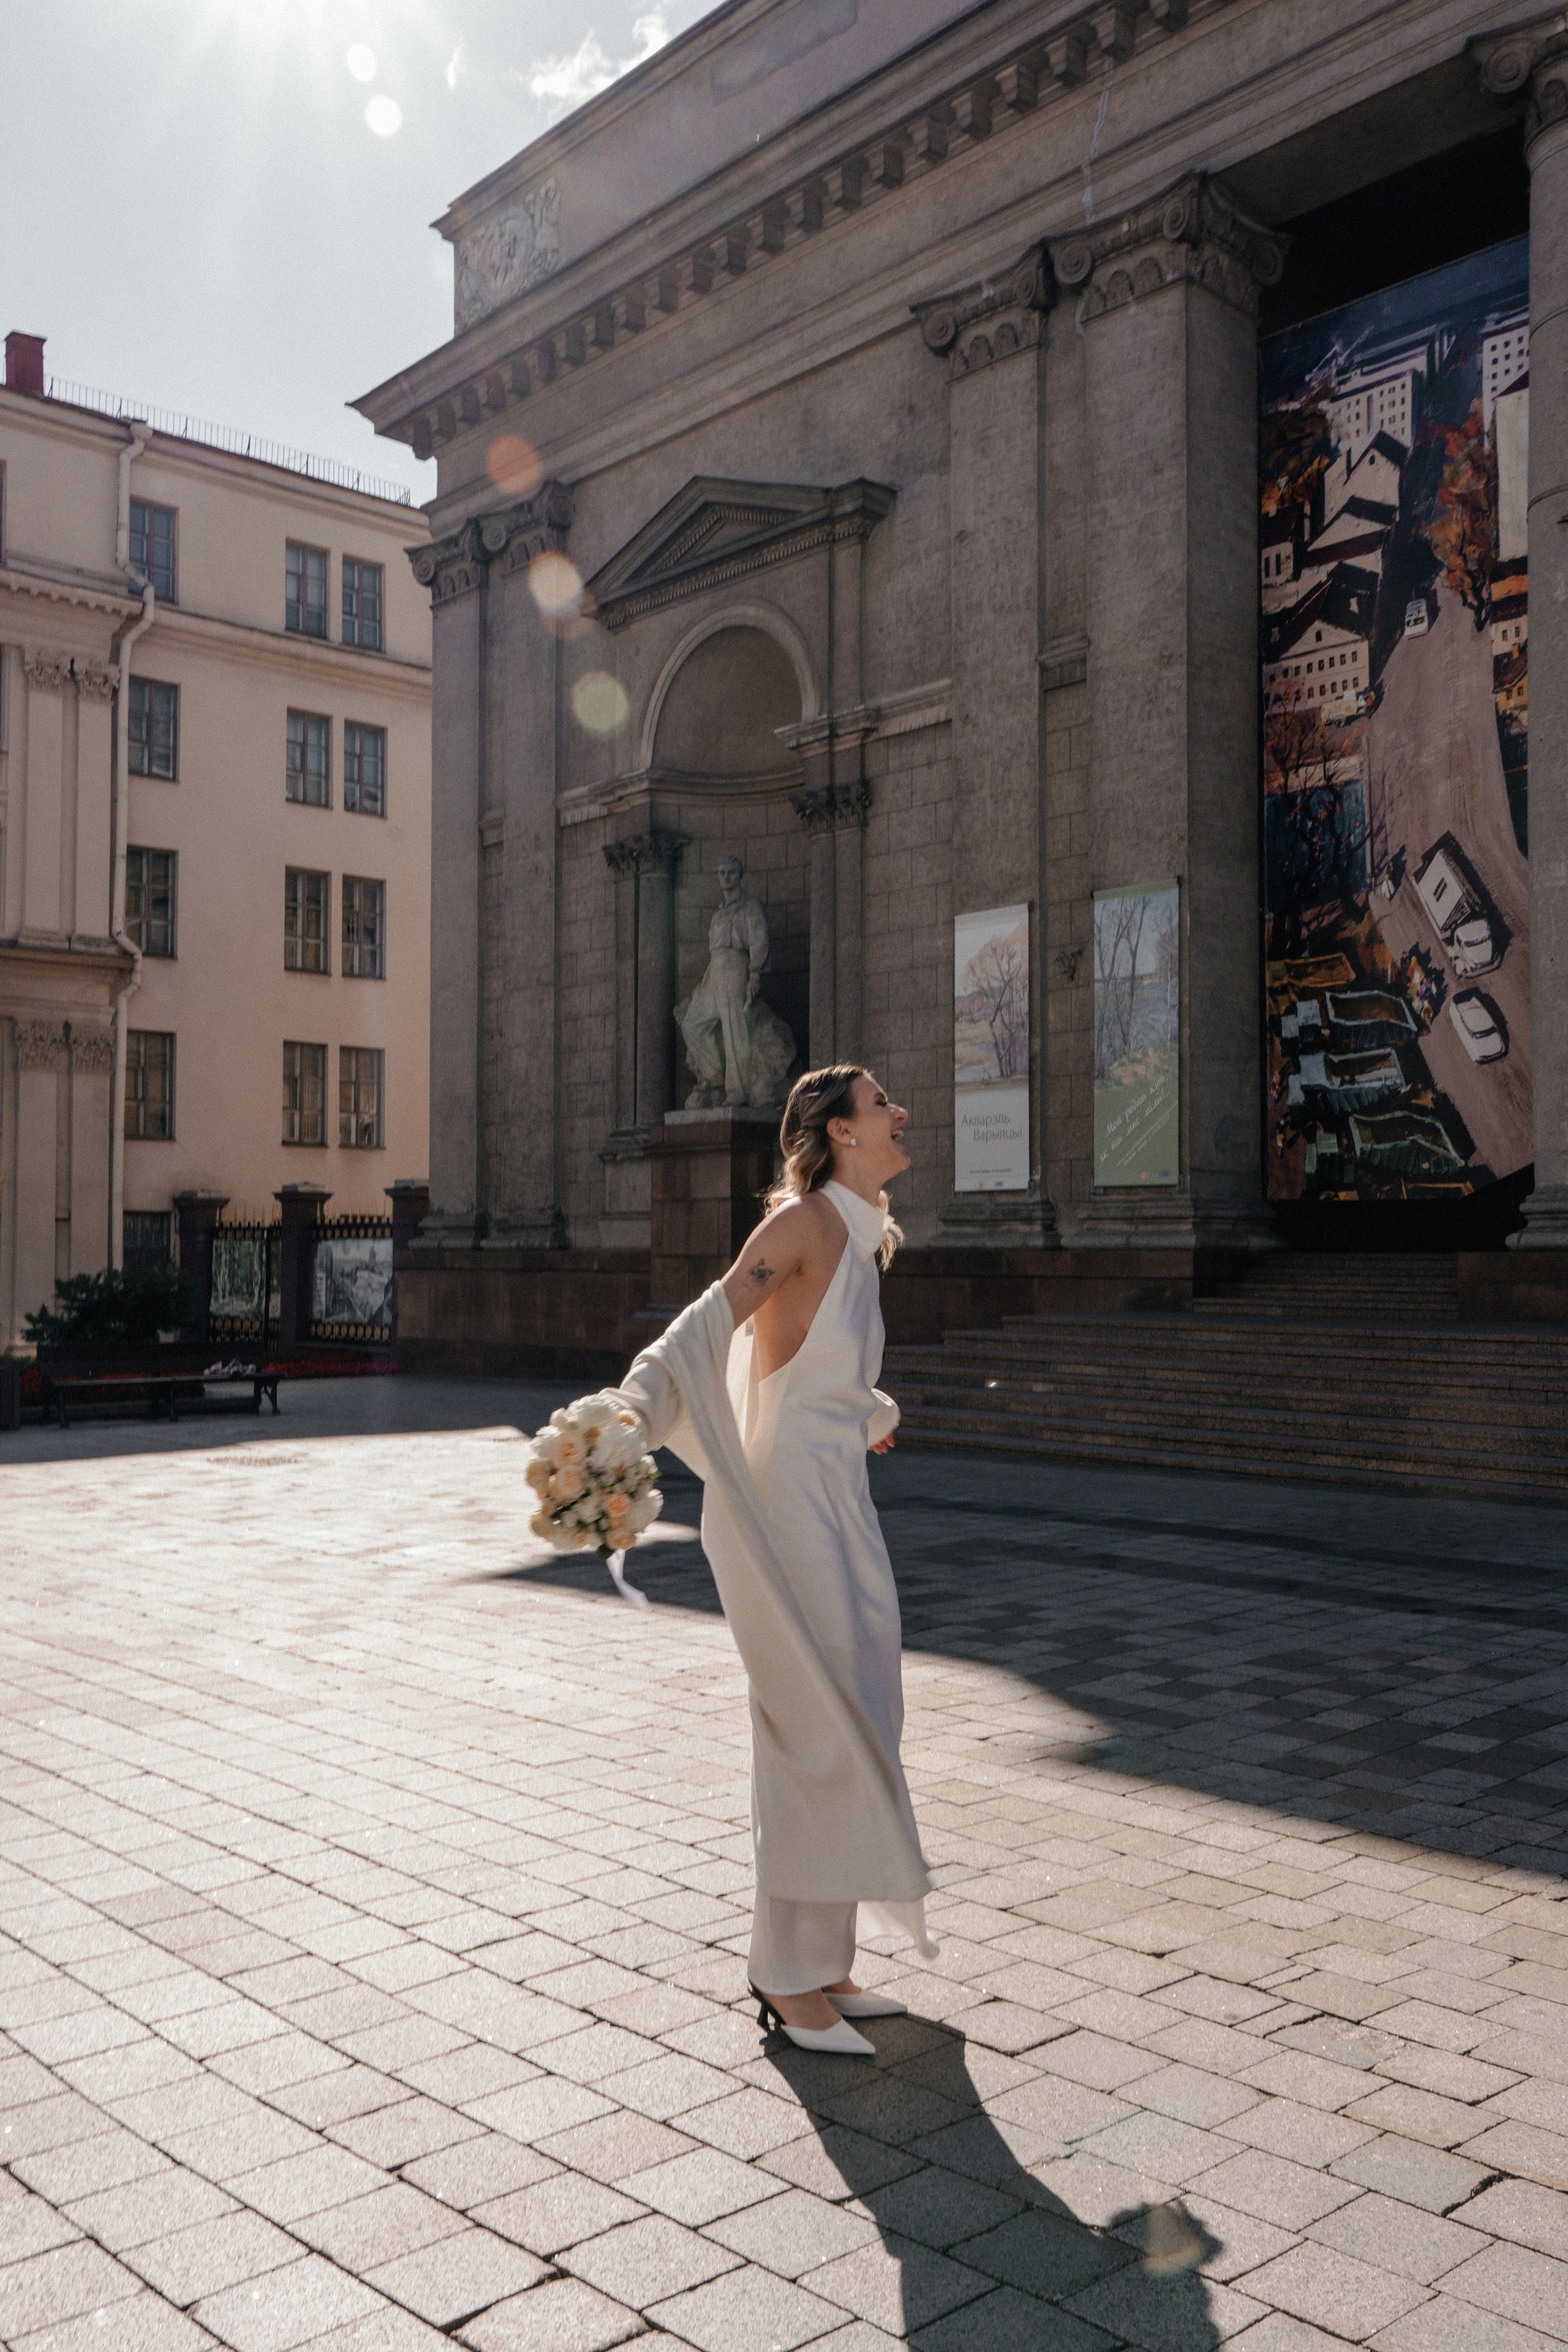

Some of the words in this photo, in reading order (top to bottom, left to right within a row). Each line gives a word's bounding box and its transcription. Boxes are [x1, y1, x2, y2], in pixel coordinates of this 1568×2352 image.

[973, 1126, 1022, 1144] Варыяцыі
[1106, 1115, 1122, 1137] Мой
[1127, 1117, 1141, 1136] мне
